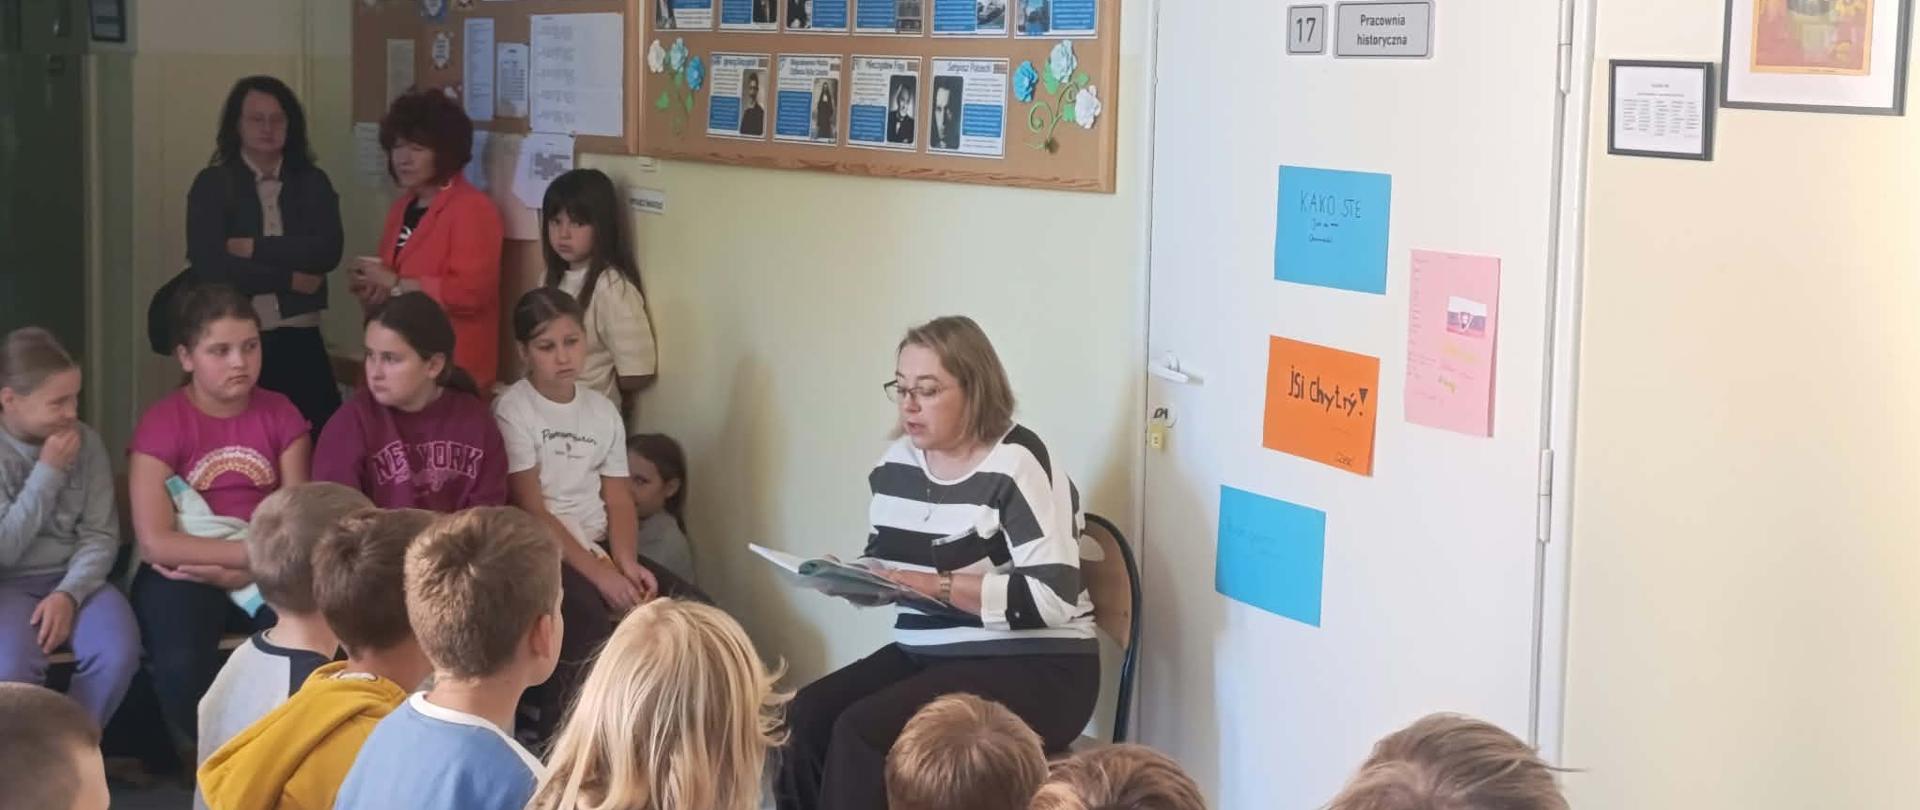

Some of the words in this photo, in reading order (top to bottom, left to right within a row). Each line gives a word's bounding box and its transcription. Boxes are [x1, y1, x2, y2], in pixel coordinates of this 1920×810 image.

[1296, 17, 1316, 43] 17
[1360, 14, 1406, 26] Pracownia
[1357, 34, 1408, 47] historyczna
[1300, 189, 1336, 216] KAKO
[416, 440, 484, 480] YORK
